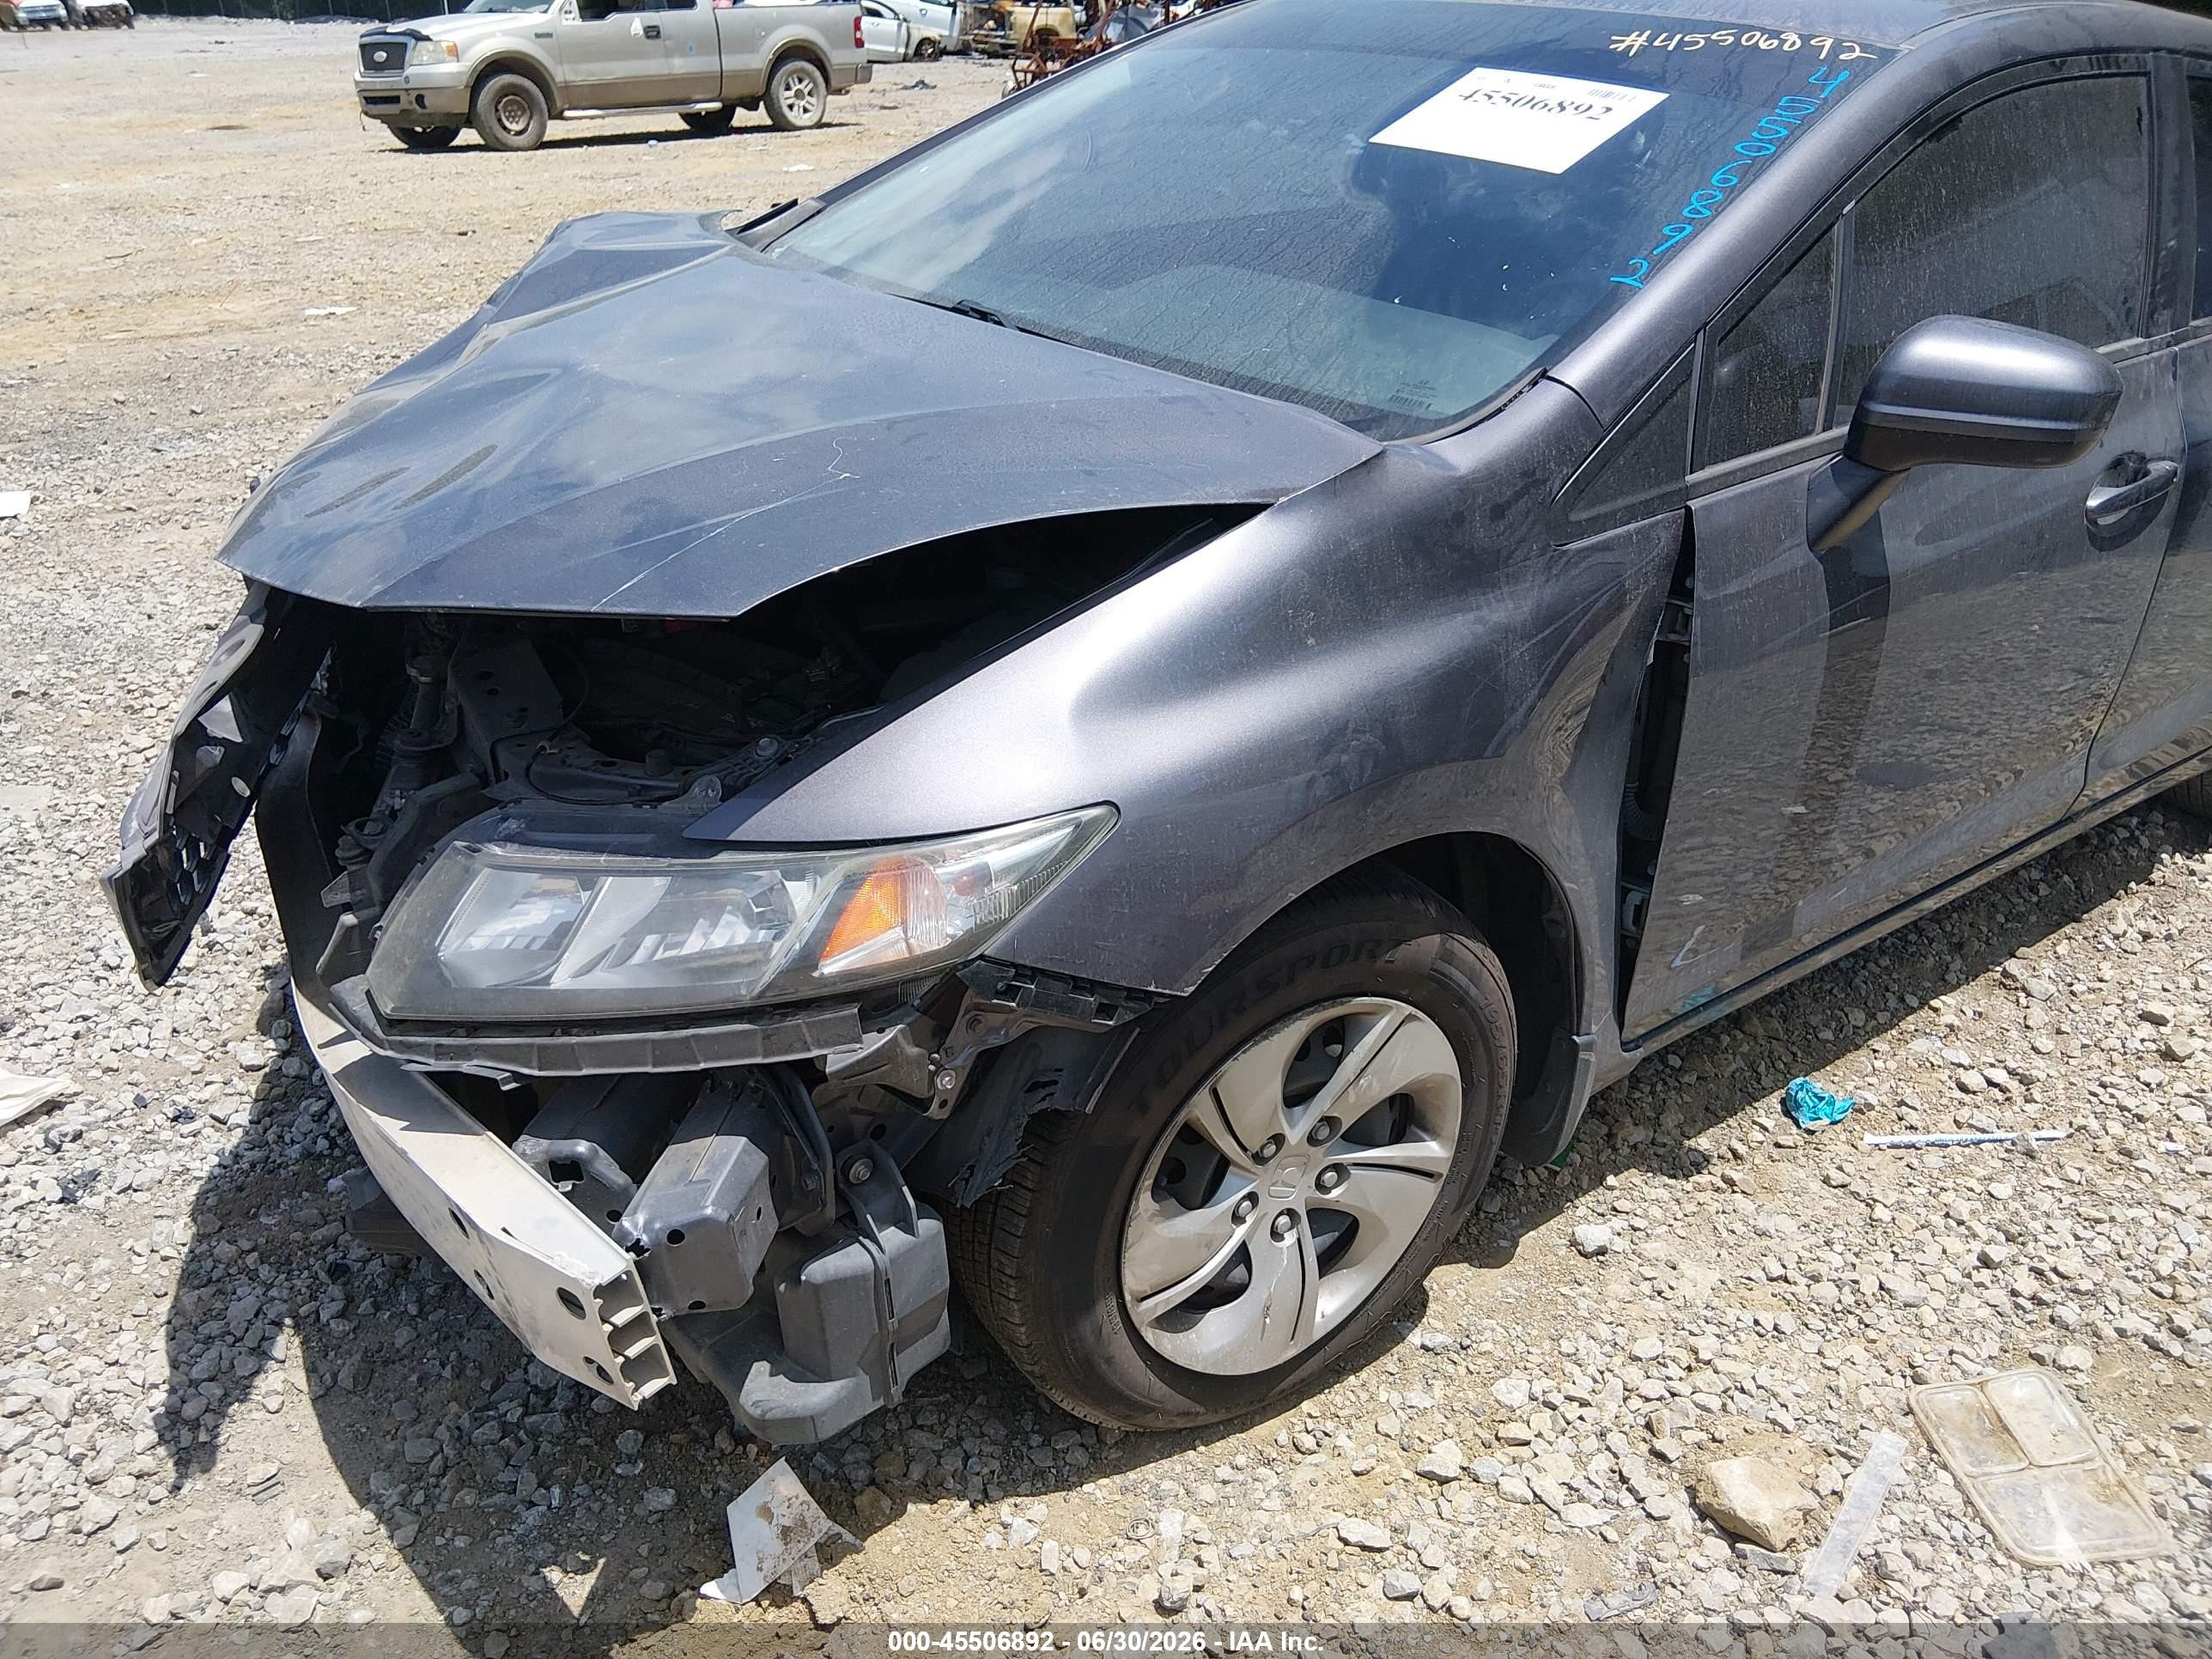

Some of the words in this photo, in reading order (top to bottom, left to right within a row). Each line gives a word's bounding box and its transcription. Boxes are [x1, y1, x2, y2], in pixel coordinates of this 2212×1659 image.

[1609, 29, 1878, 60] #45506892
[1458, 88, 1613, 120] 45506892
[1609, 65, 1850, 289] 45506892
